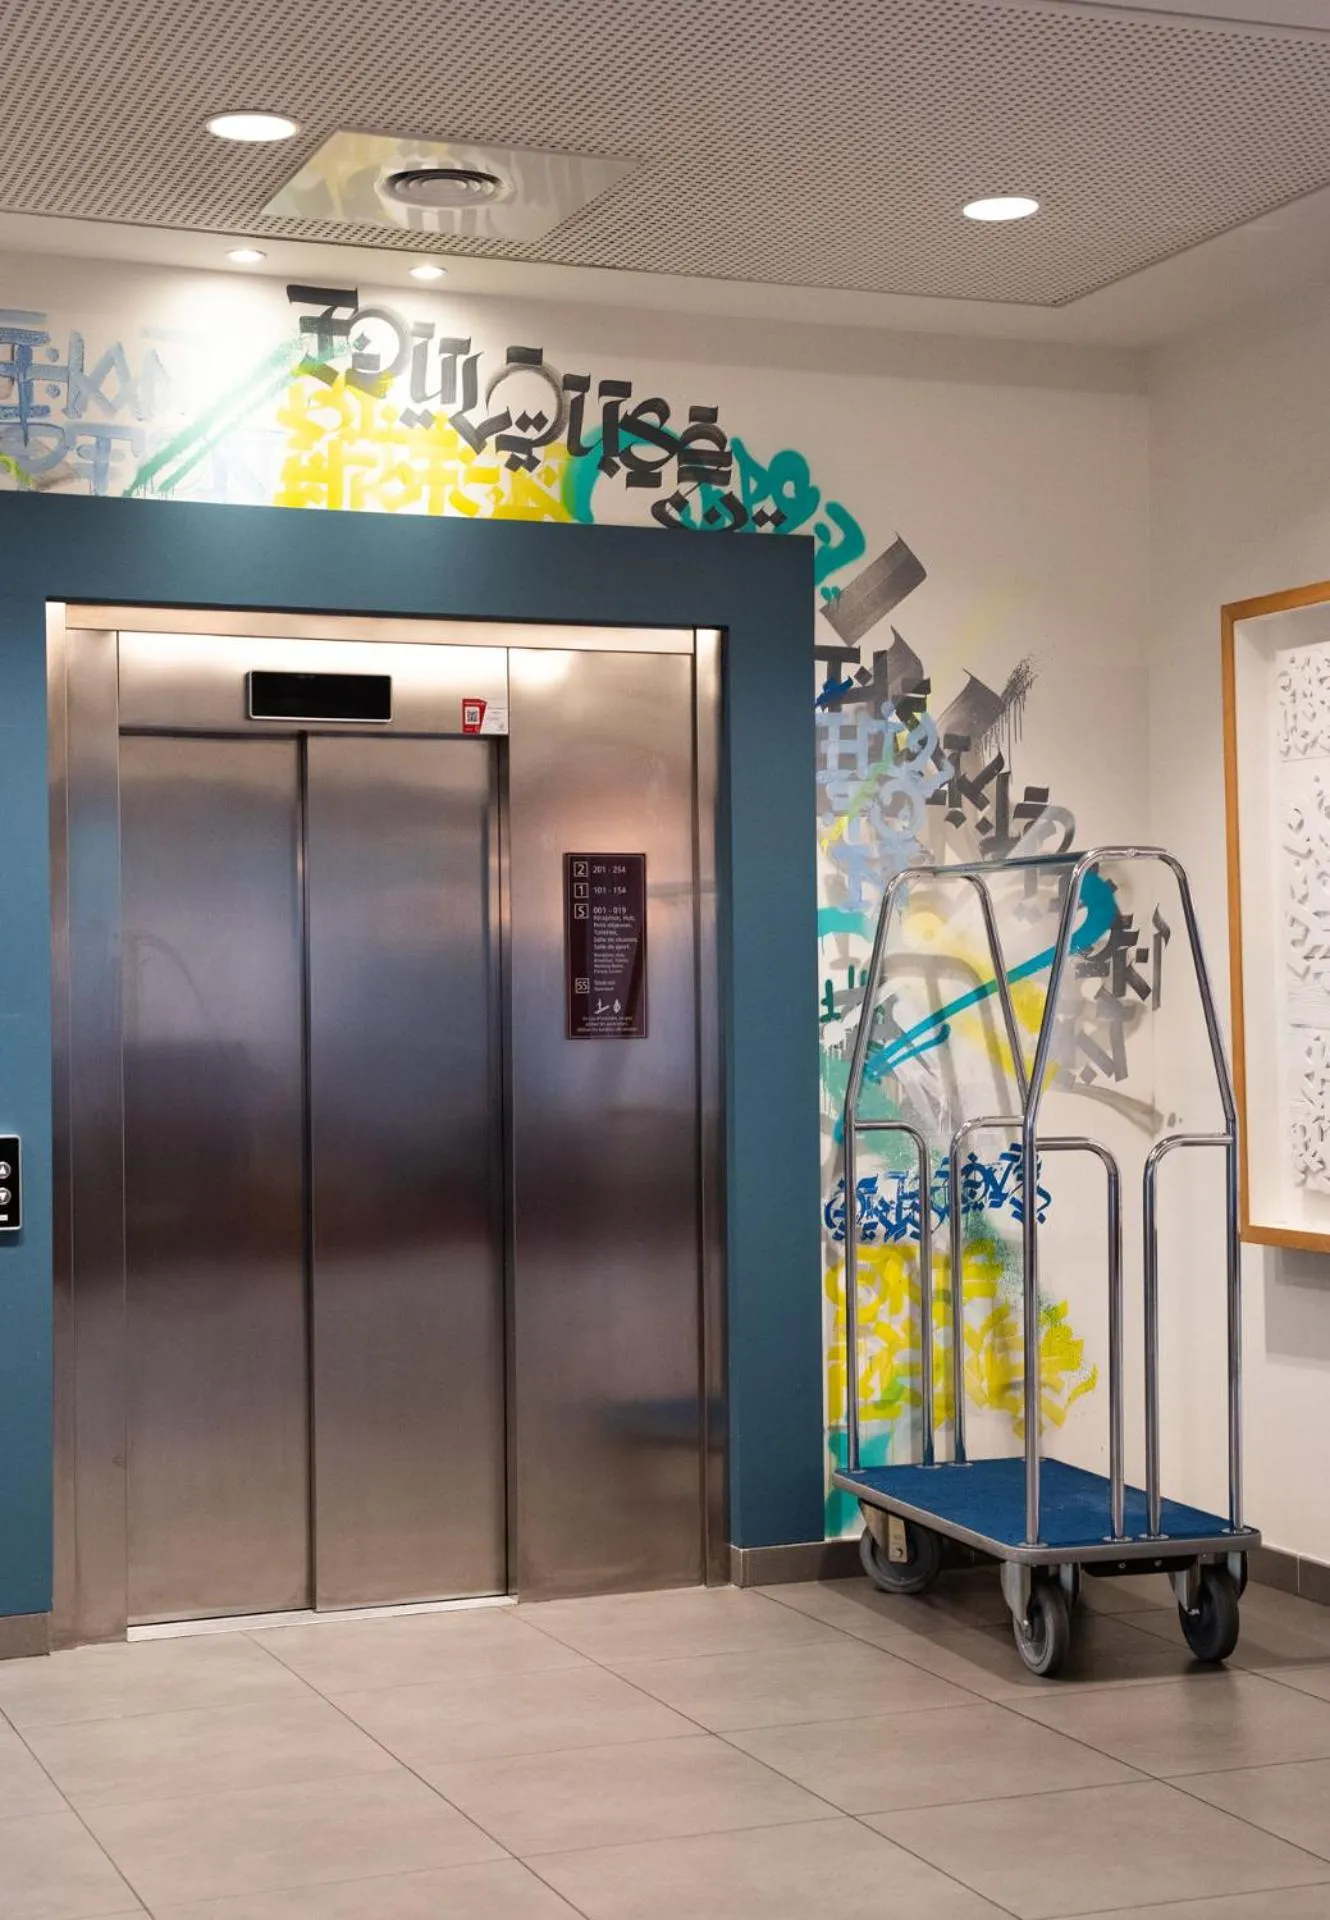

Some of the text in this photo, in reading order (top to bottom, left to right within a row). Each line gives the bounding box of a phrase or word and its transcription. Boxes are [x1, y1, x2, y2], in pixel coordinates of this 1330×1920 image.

[577, 864, 585, 875] 2
[592, 865, 606, 874] 201
[578, 885, 584, 895] 1
[577, 905, 585, 917] S
